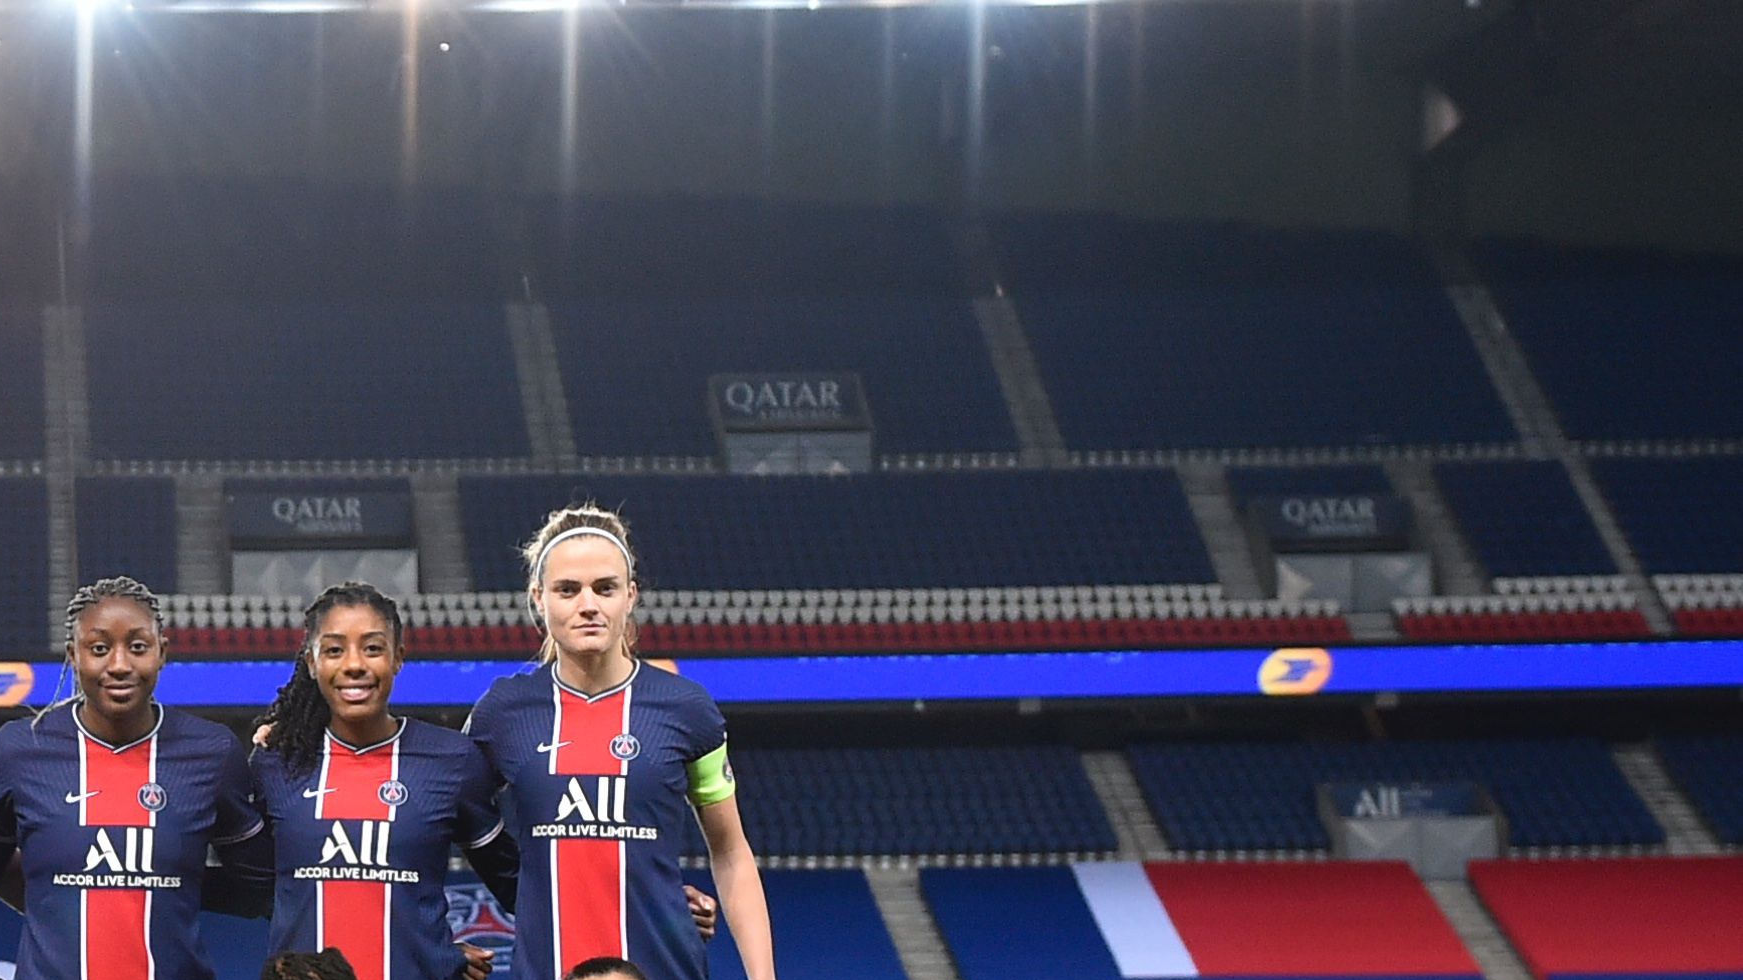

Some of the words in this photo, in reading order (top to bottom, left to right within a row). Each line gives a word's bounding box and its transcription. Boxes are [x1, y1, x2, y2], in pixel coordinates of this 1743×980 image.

[725, 381, 841, 415] QATAR
[273, 498, 362, 522] QATAR
[1282, 498, 1375, 526] QATAR
[569, 825, 597, 837] LIVE
[599, 825, 657, 839] LIMITLESS
[53, 874, 94, 886] ACCOR
[97, 875, 125, 887] LIVE
[127, 875, 181, 888] LIMITLESS
[294, 867, 330, 878] ACCOR
[333, 867, 360, 879] LIVE
[362, 868, 419, 883] LIMITLESS
